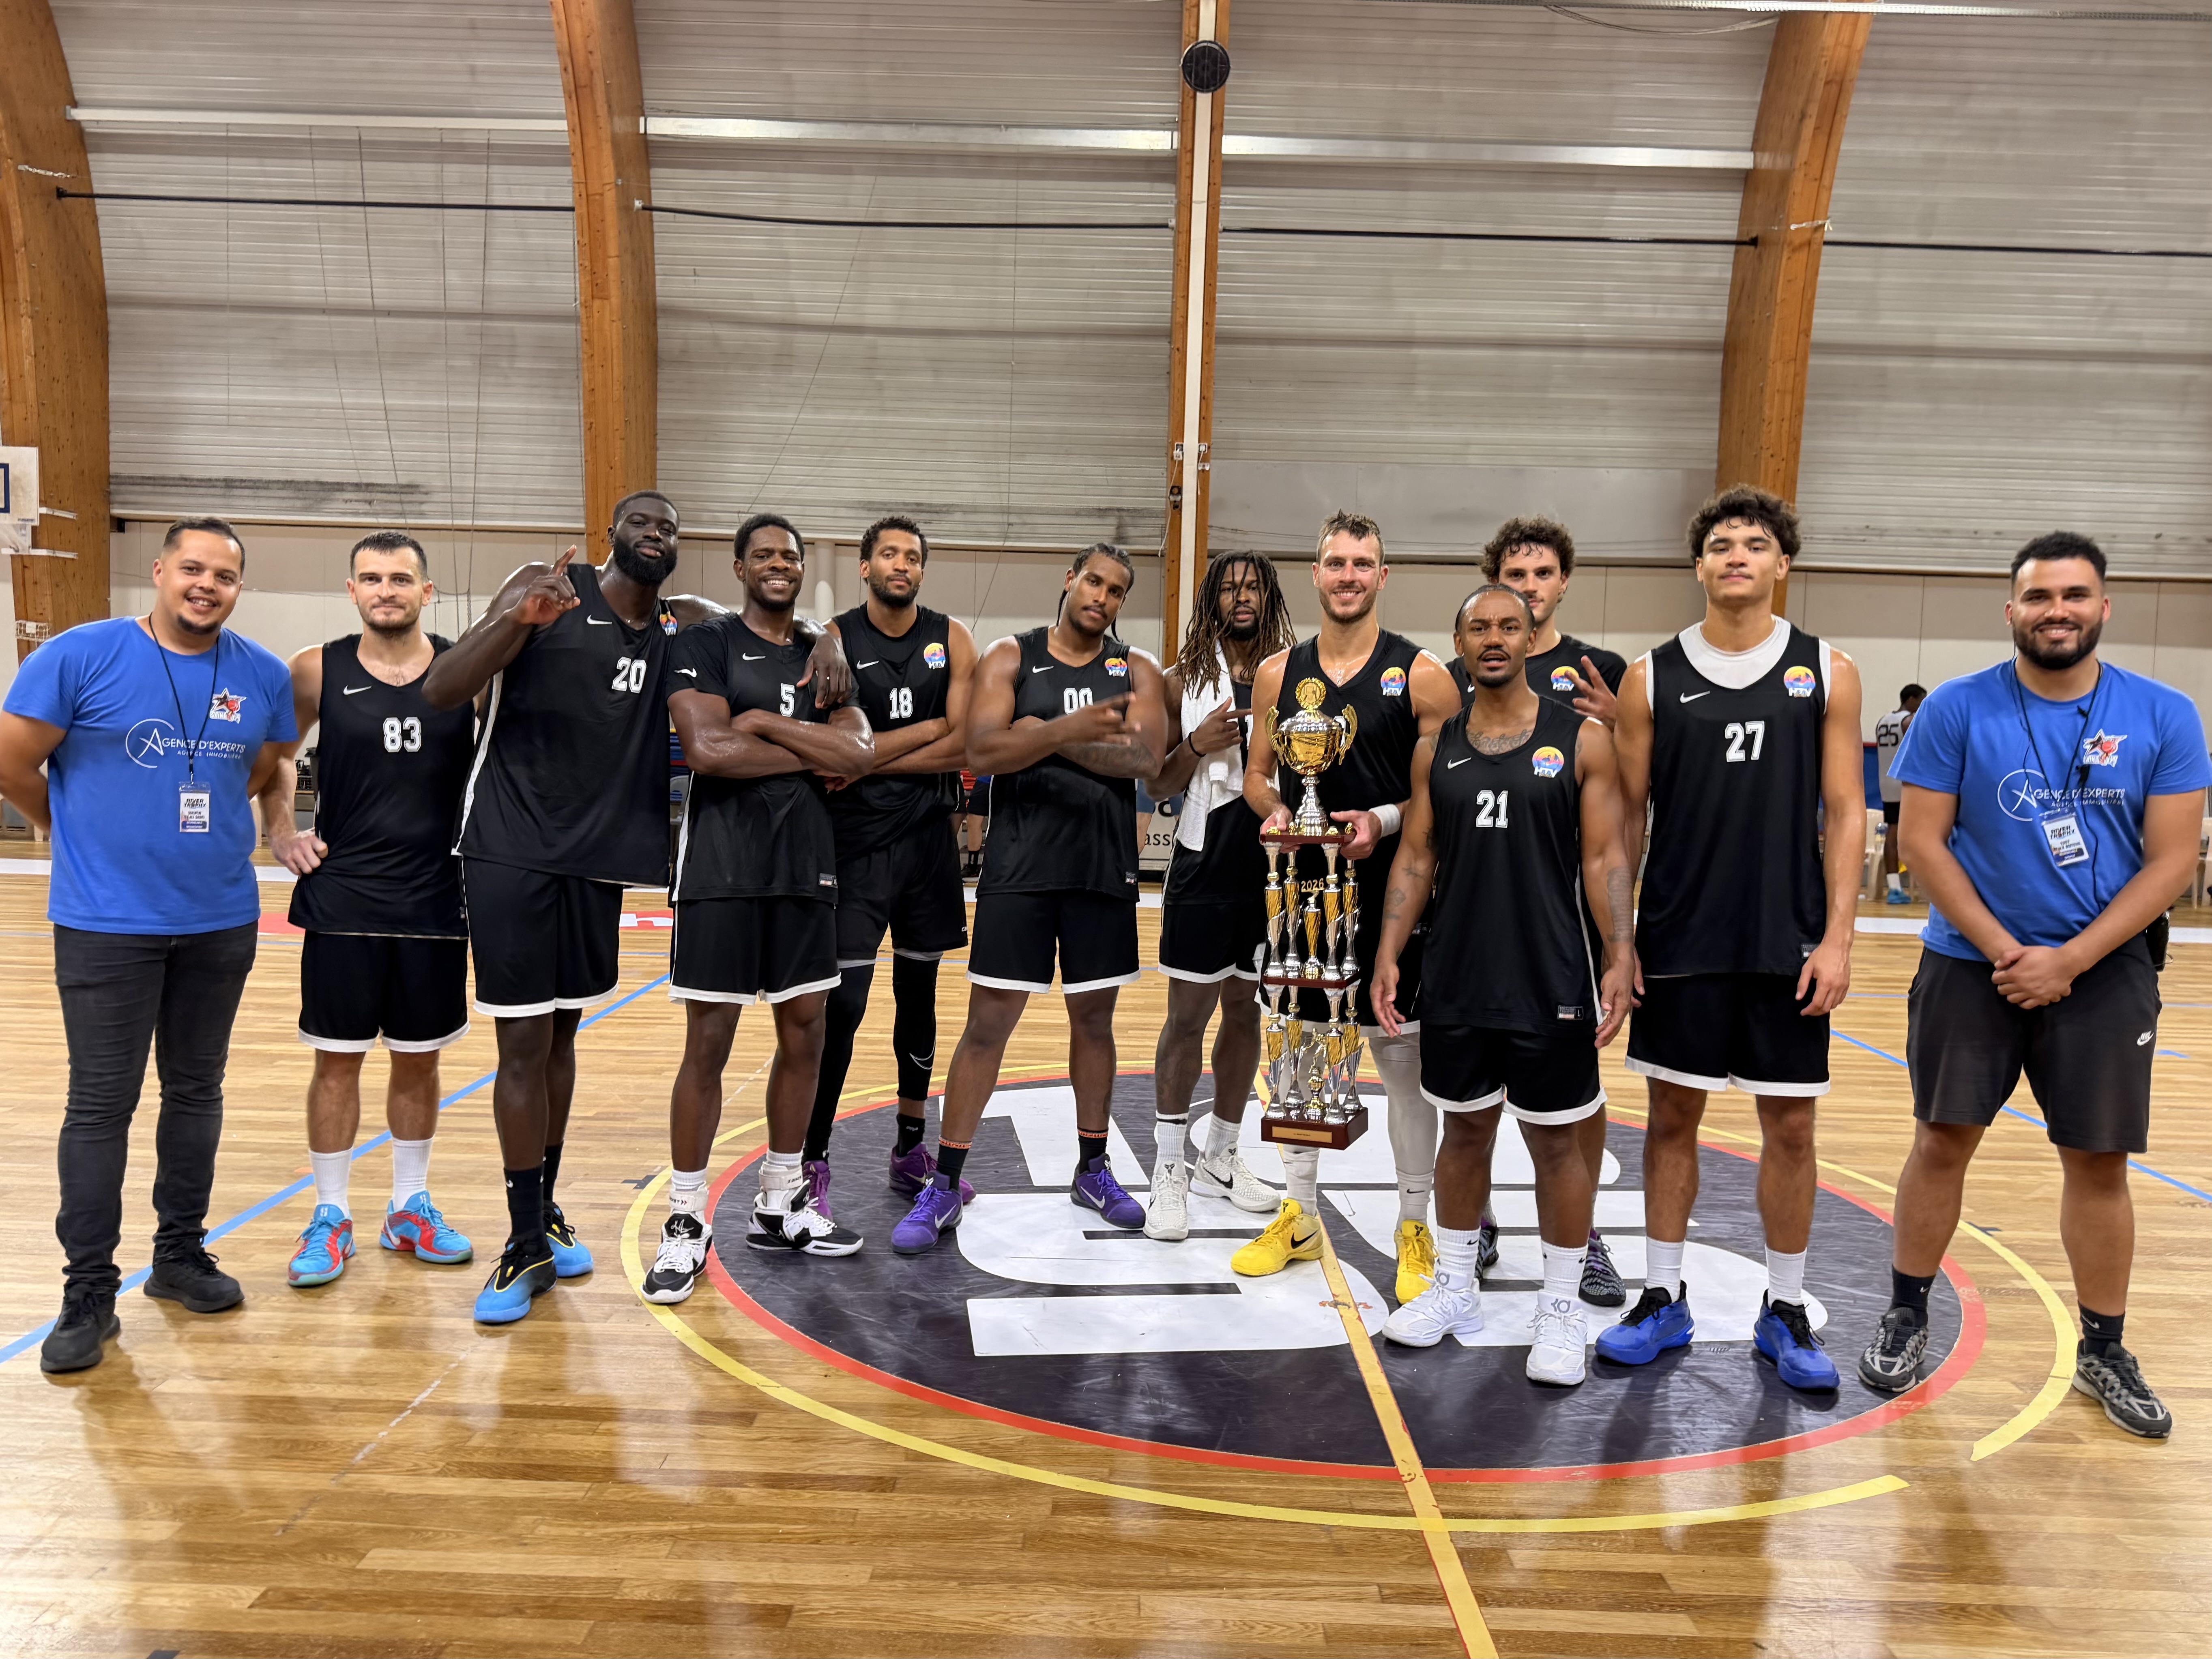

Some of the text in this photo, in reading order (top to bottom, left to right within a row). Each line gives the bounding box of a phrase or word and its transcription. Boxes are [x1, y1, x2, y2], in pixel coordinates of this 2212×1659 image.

[611, 657, 647, 693] 20
[780, 683, 795, 717] 5
[889, 687, 913, 719] 18
[1064, 687, 1093, 715] 00
[383, 717, 421, 753] 83
[1725, 721, 1765, 762] 27
[1878, 724, 1899, 747] 25
[1476, 790, 1508, 828] 21
[1301, 878, 1324, 891] 2026
